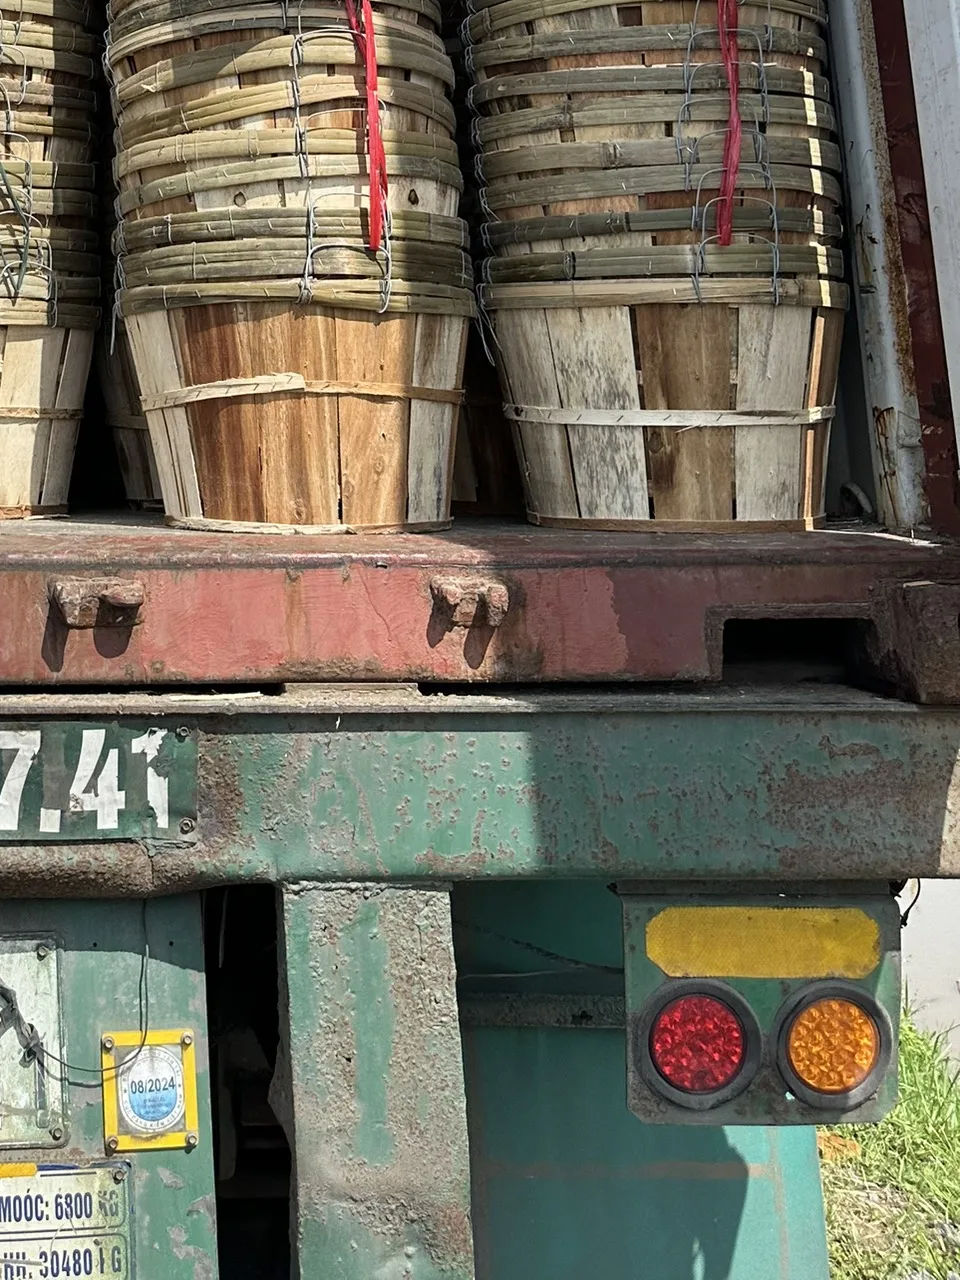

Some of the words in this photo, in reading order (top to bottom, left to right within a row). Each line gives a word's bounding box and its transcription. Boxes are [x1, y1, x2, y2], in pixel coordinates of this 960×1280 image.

[130, 1076, 176, 1095] 08/2024
[54, 1191, 93, 1221] 6800
[39, 1247, 93, 1279] 30480
